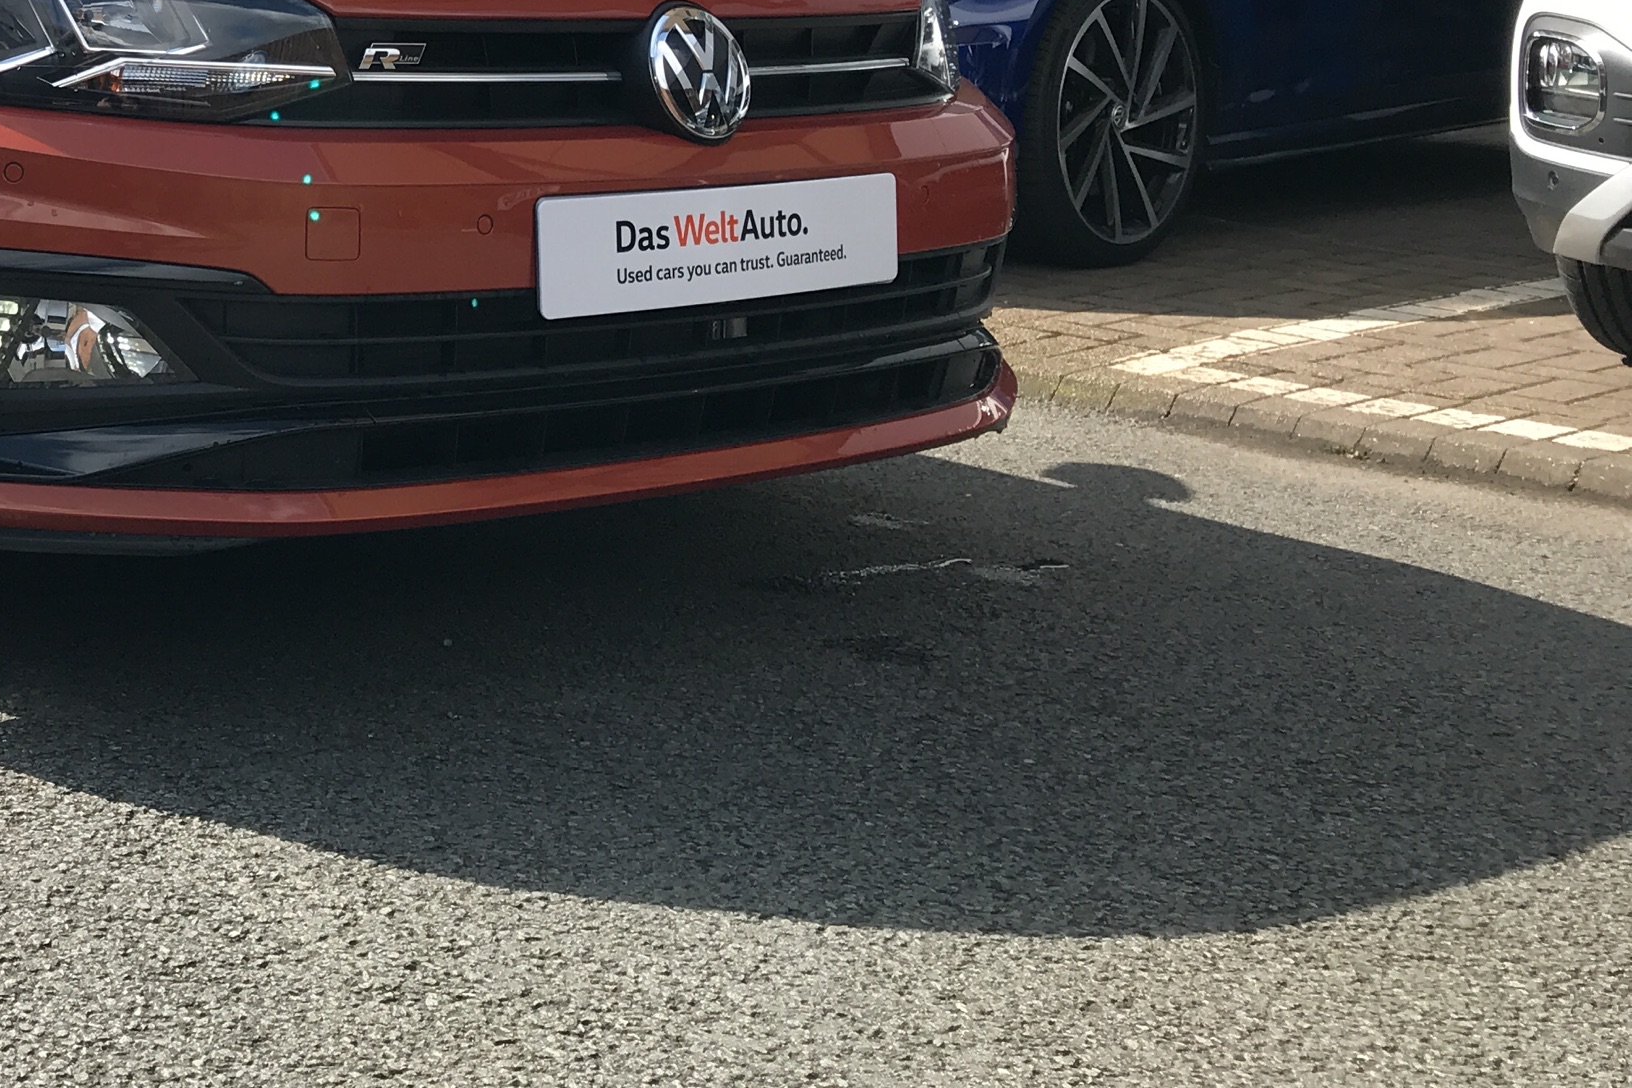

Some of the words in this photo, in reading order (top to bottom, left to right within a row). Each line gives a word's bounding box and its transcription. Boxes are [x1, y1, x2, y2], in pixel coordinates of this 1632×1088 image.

[616, 220, 670, 253] Das
[617, 265, 653, 284] Used
[656, 264, 685, 281] cars
[687, 262, 712, 282] you
[715, 258, 738, 275] can
[740, 256, 774, 272] trust.
[776, 244, 847, 268] Guaranteed.
